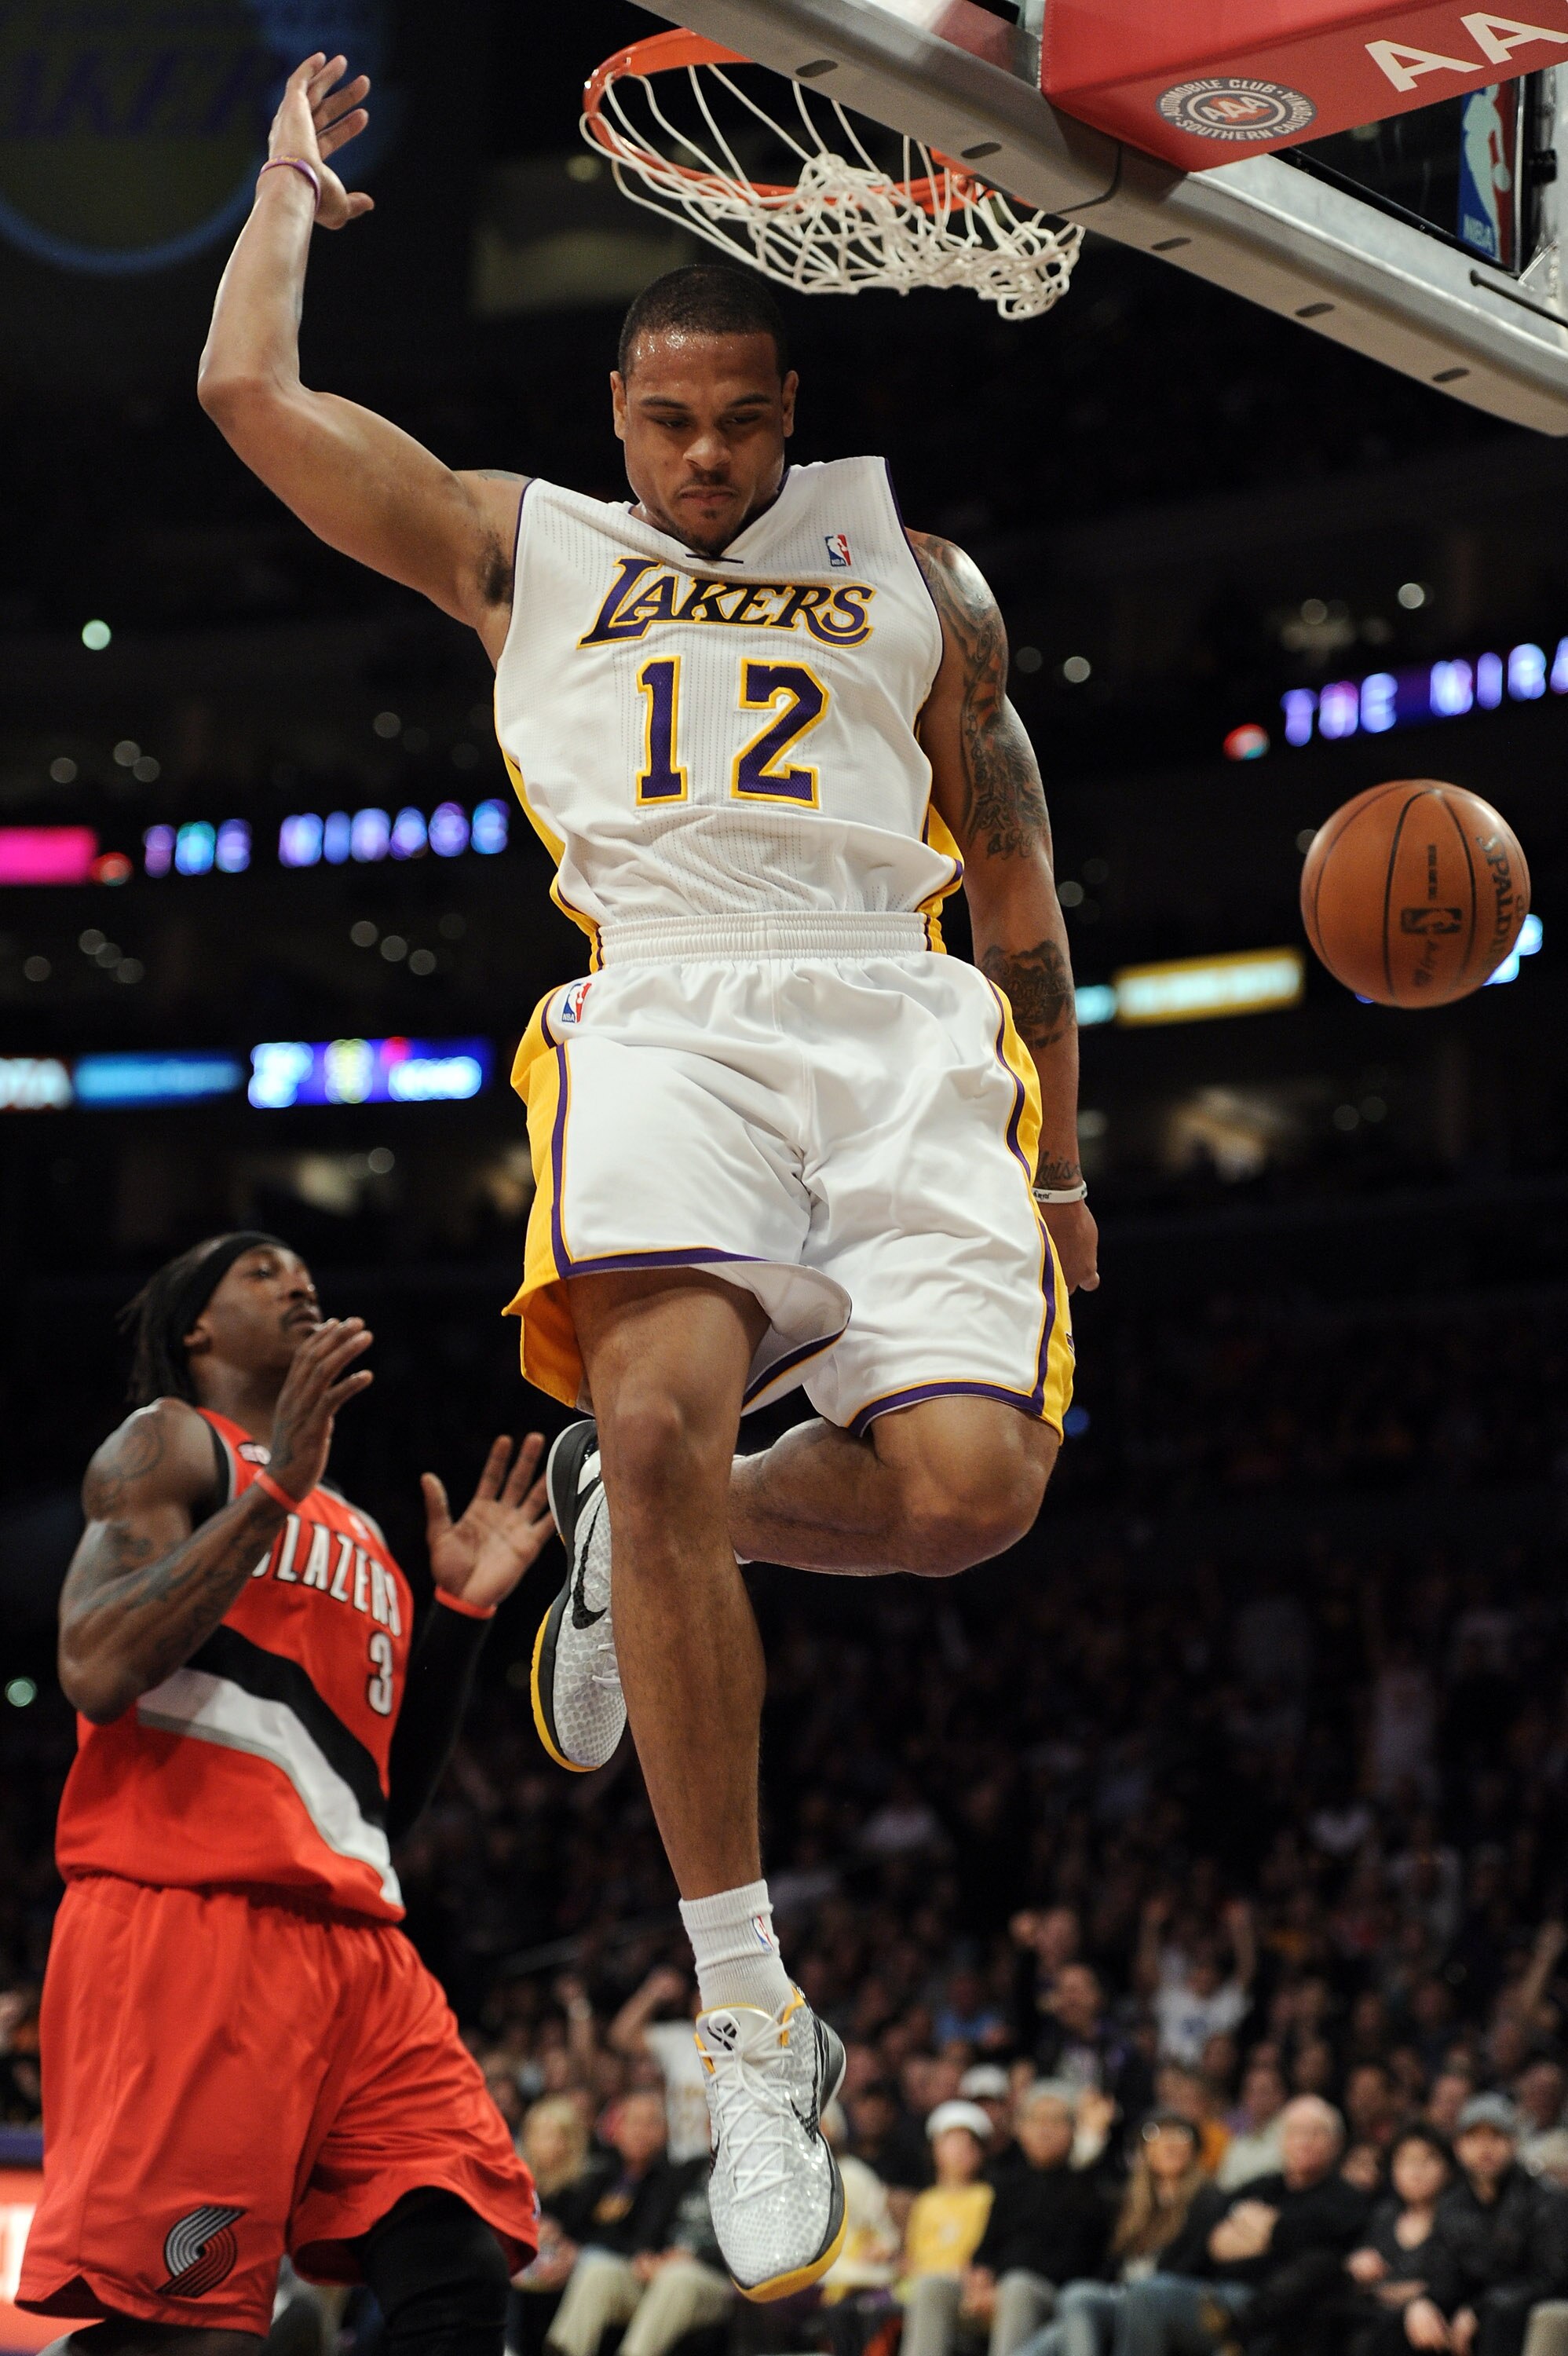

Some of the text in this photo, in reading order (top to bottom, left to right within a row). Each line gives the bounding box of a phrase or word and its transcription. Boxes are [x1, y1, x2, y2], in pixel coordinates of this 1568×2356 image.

[1160, 79, 1277, 117] AUTOMOBILE CLUB
[1176, 91, 1314, 141] SOUTHERN CALIFORNIA
[1200, 96, 1270, 121] AAA
[576, 555, 877, 649] LAKERS
[636, 655, 829, 809] 12
[252, 1514, 401, 1637] LAZERS
[369, 1631, 392, 1716] 3
